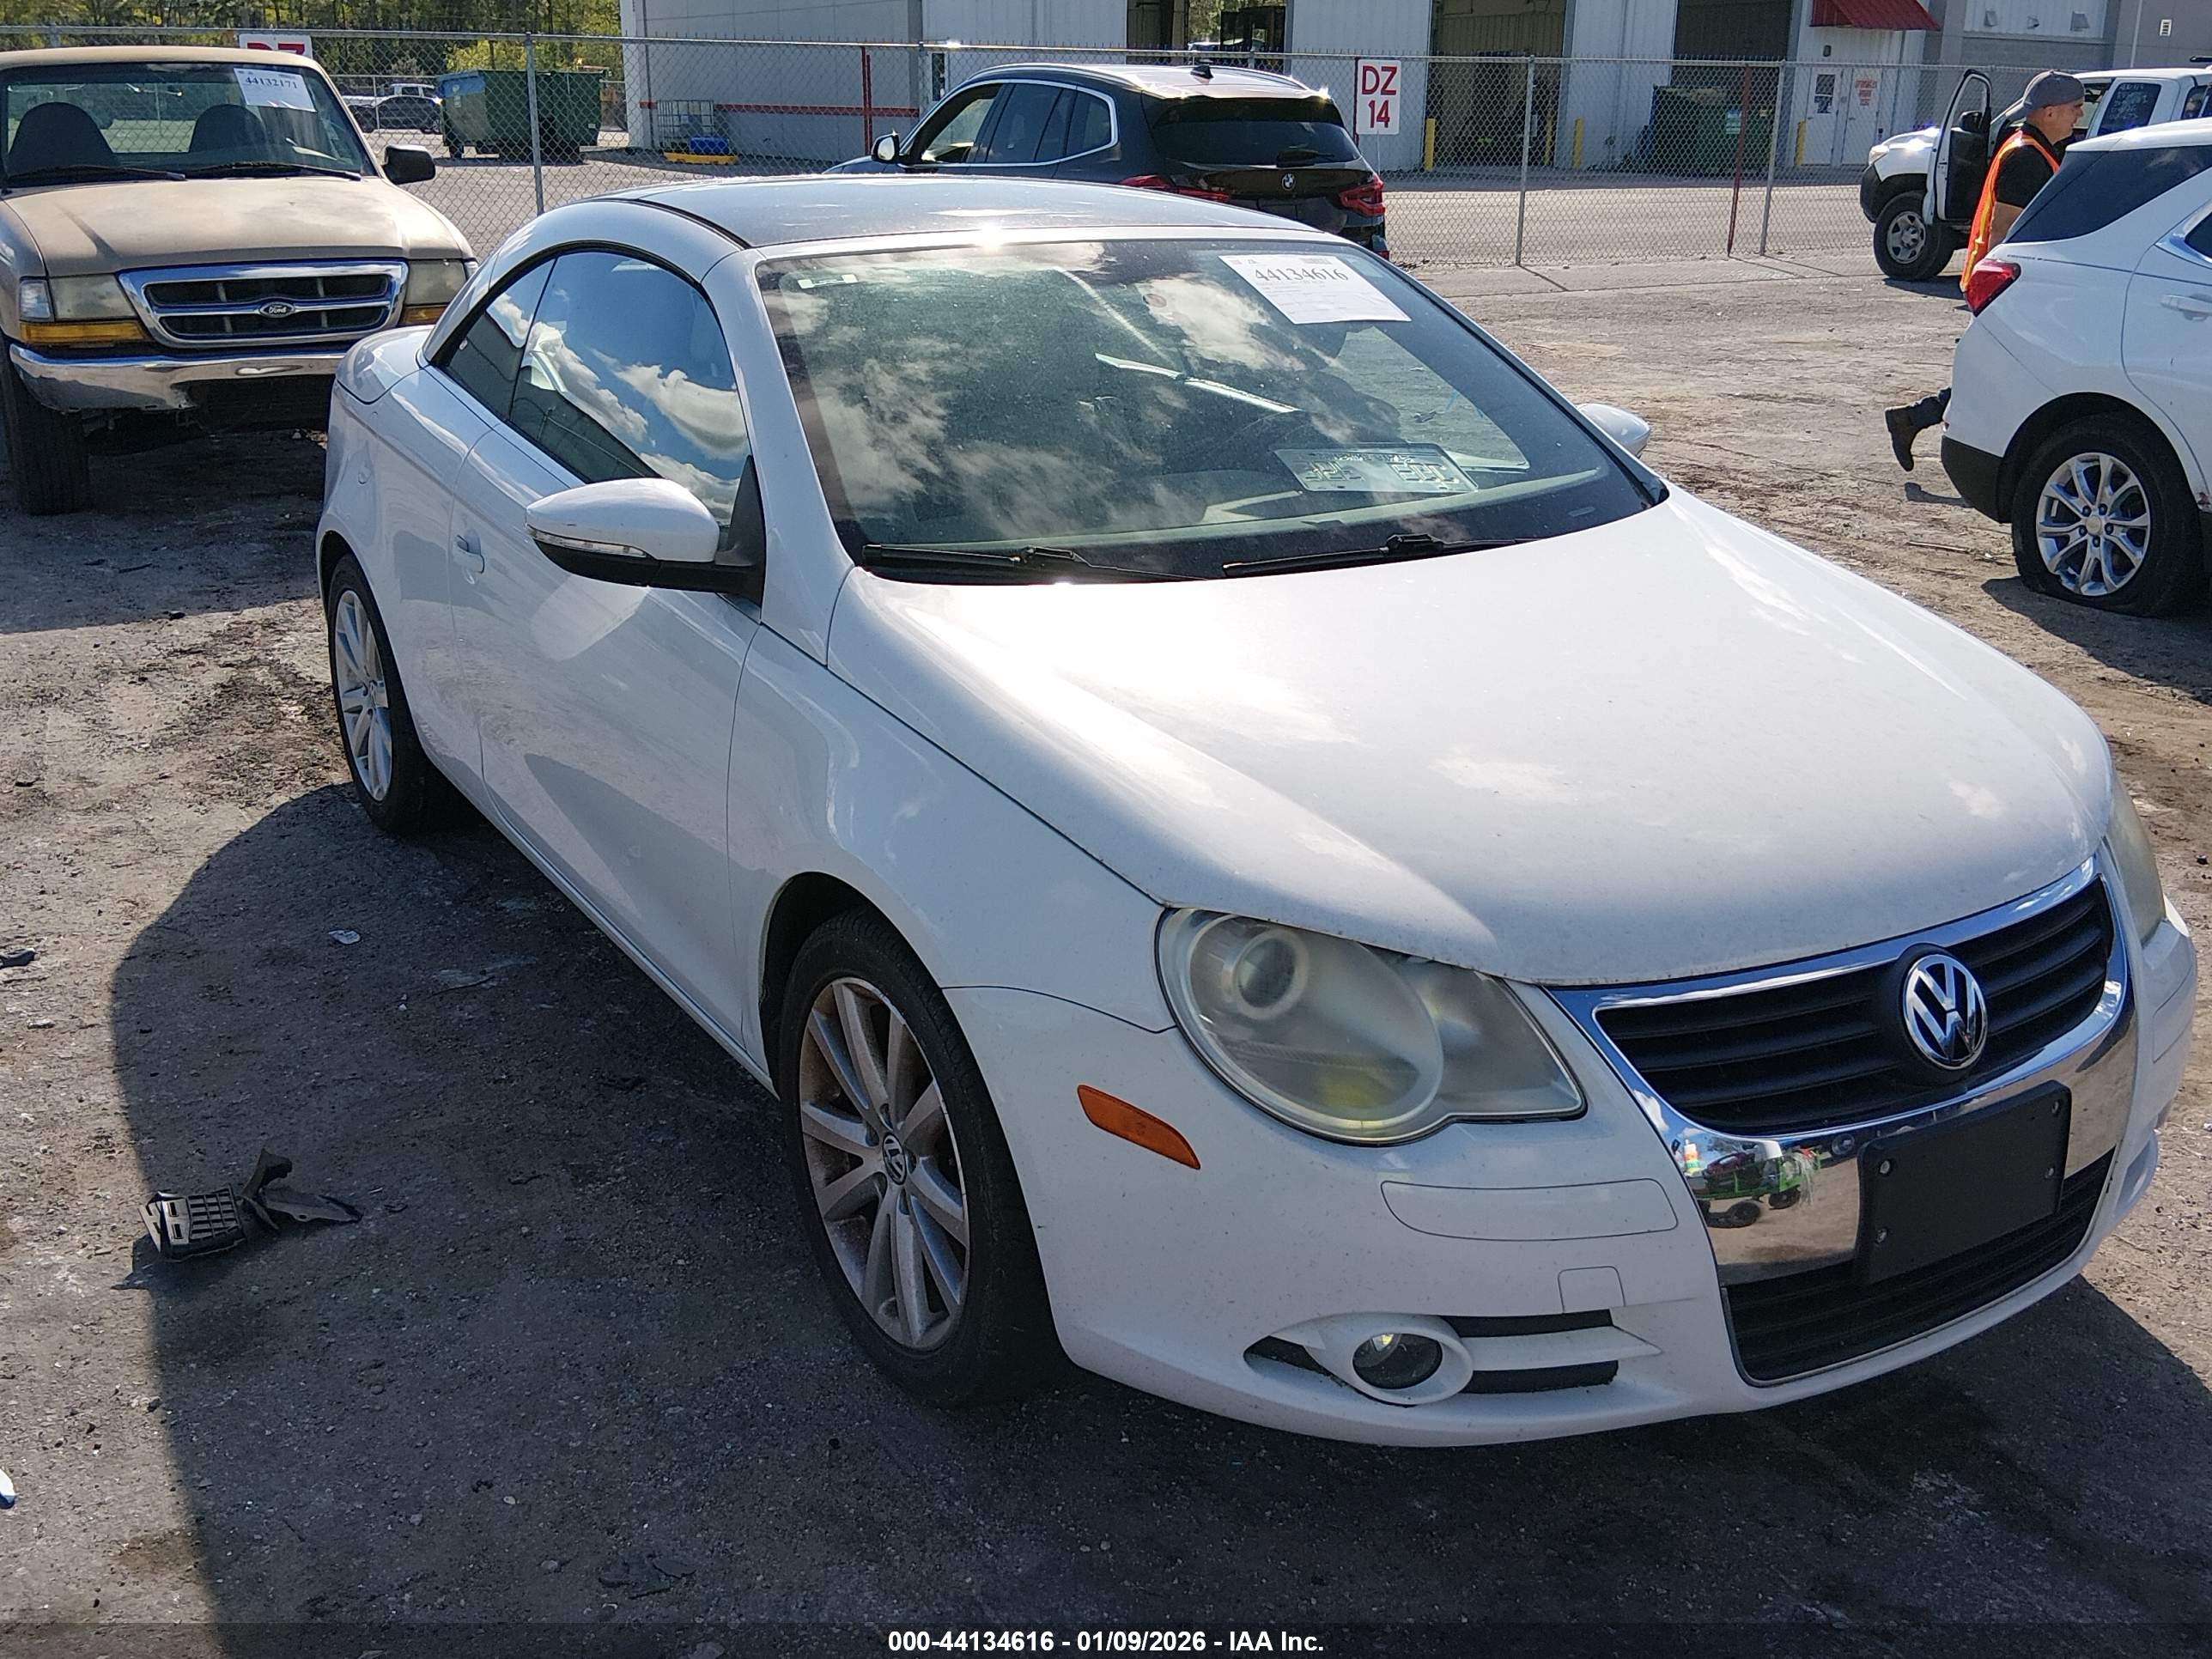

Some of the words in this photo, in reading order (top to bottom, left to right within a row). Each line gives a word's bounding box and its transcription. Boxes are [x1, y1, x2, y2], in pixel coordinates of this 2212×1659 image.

[246, 76, 297, 88] 44132171
[1361, 65, 1398, 95] DZ
[1368, 99, 1391, 129] 14
[1255, 267, 1349, 282] 44134616
